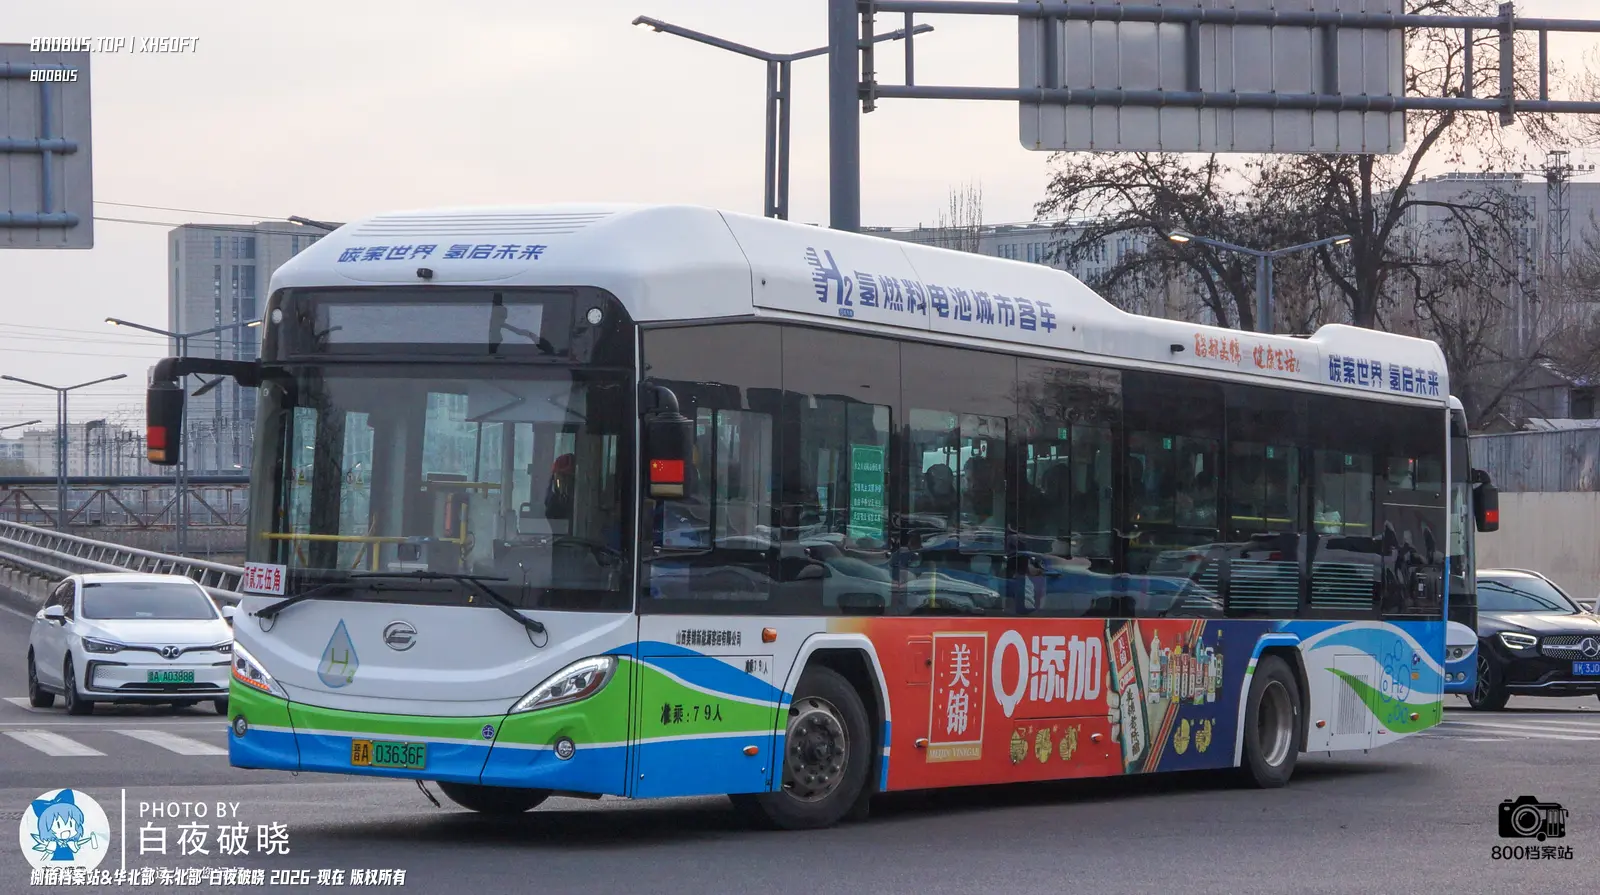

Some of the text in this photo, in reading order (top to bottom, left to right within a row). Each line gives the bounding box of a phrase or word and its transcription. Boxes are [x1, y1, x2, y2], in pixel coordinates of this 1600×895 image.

[337, 244, 548, 263] 碳索世界 氢启未来
[853, 270, 1058, 333] 氢燃料电池城市客车
[1328, 354, 1440, 396] 碳索世界 氢启未来
